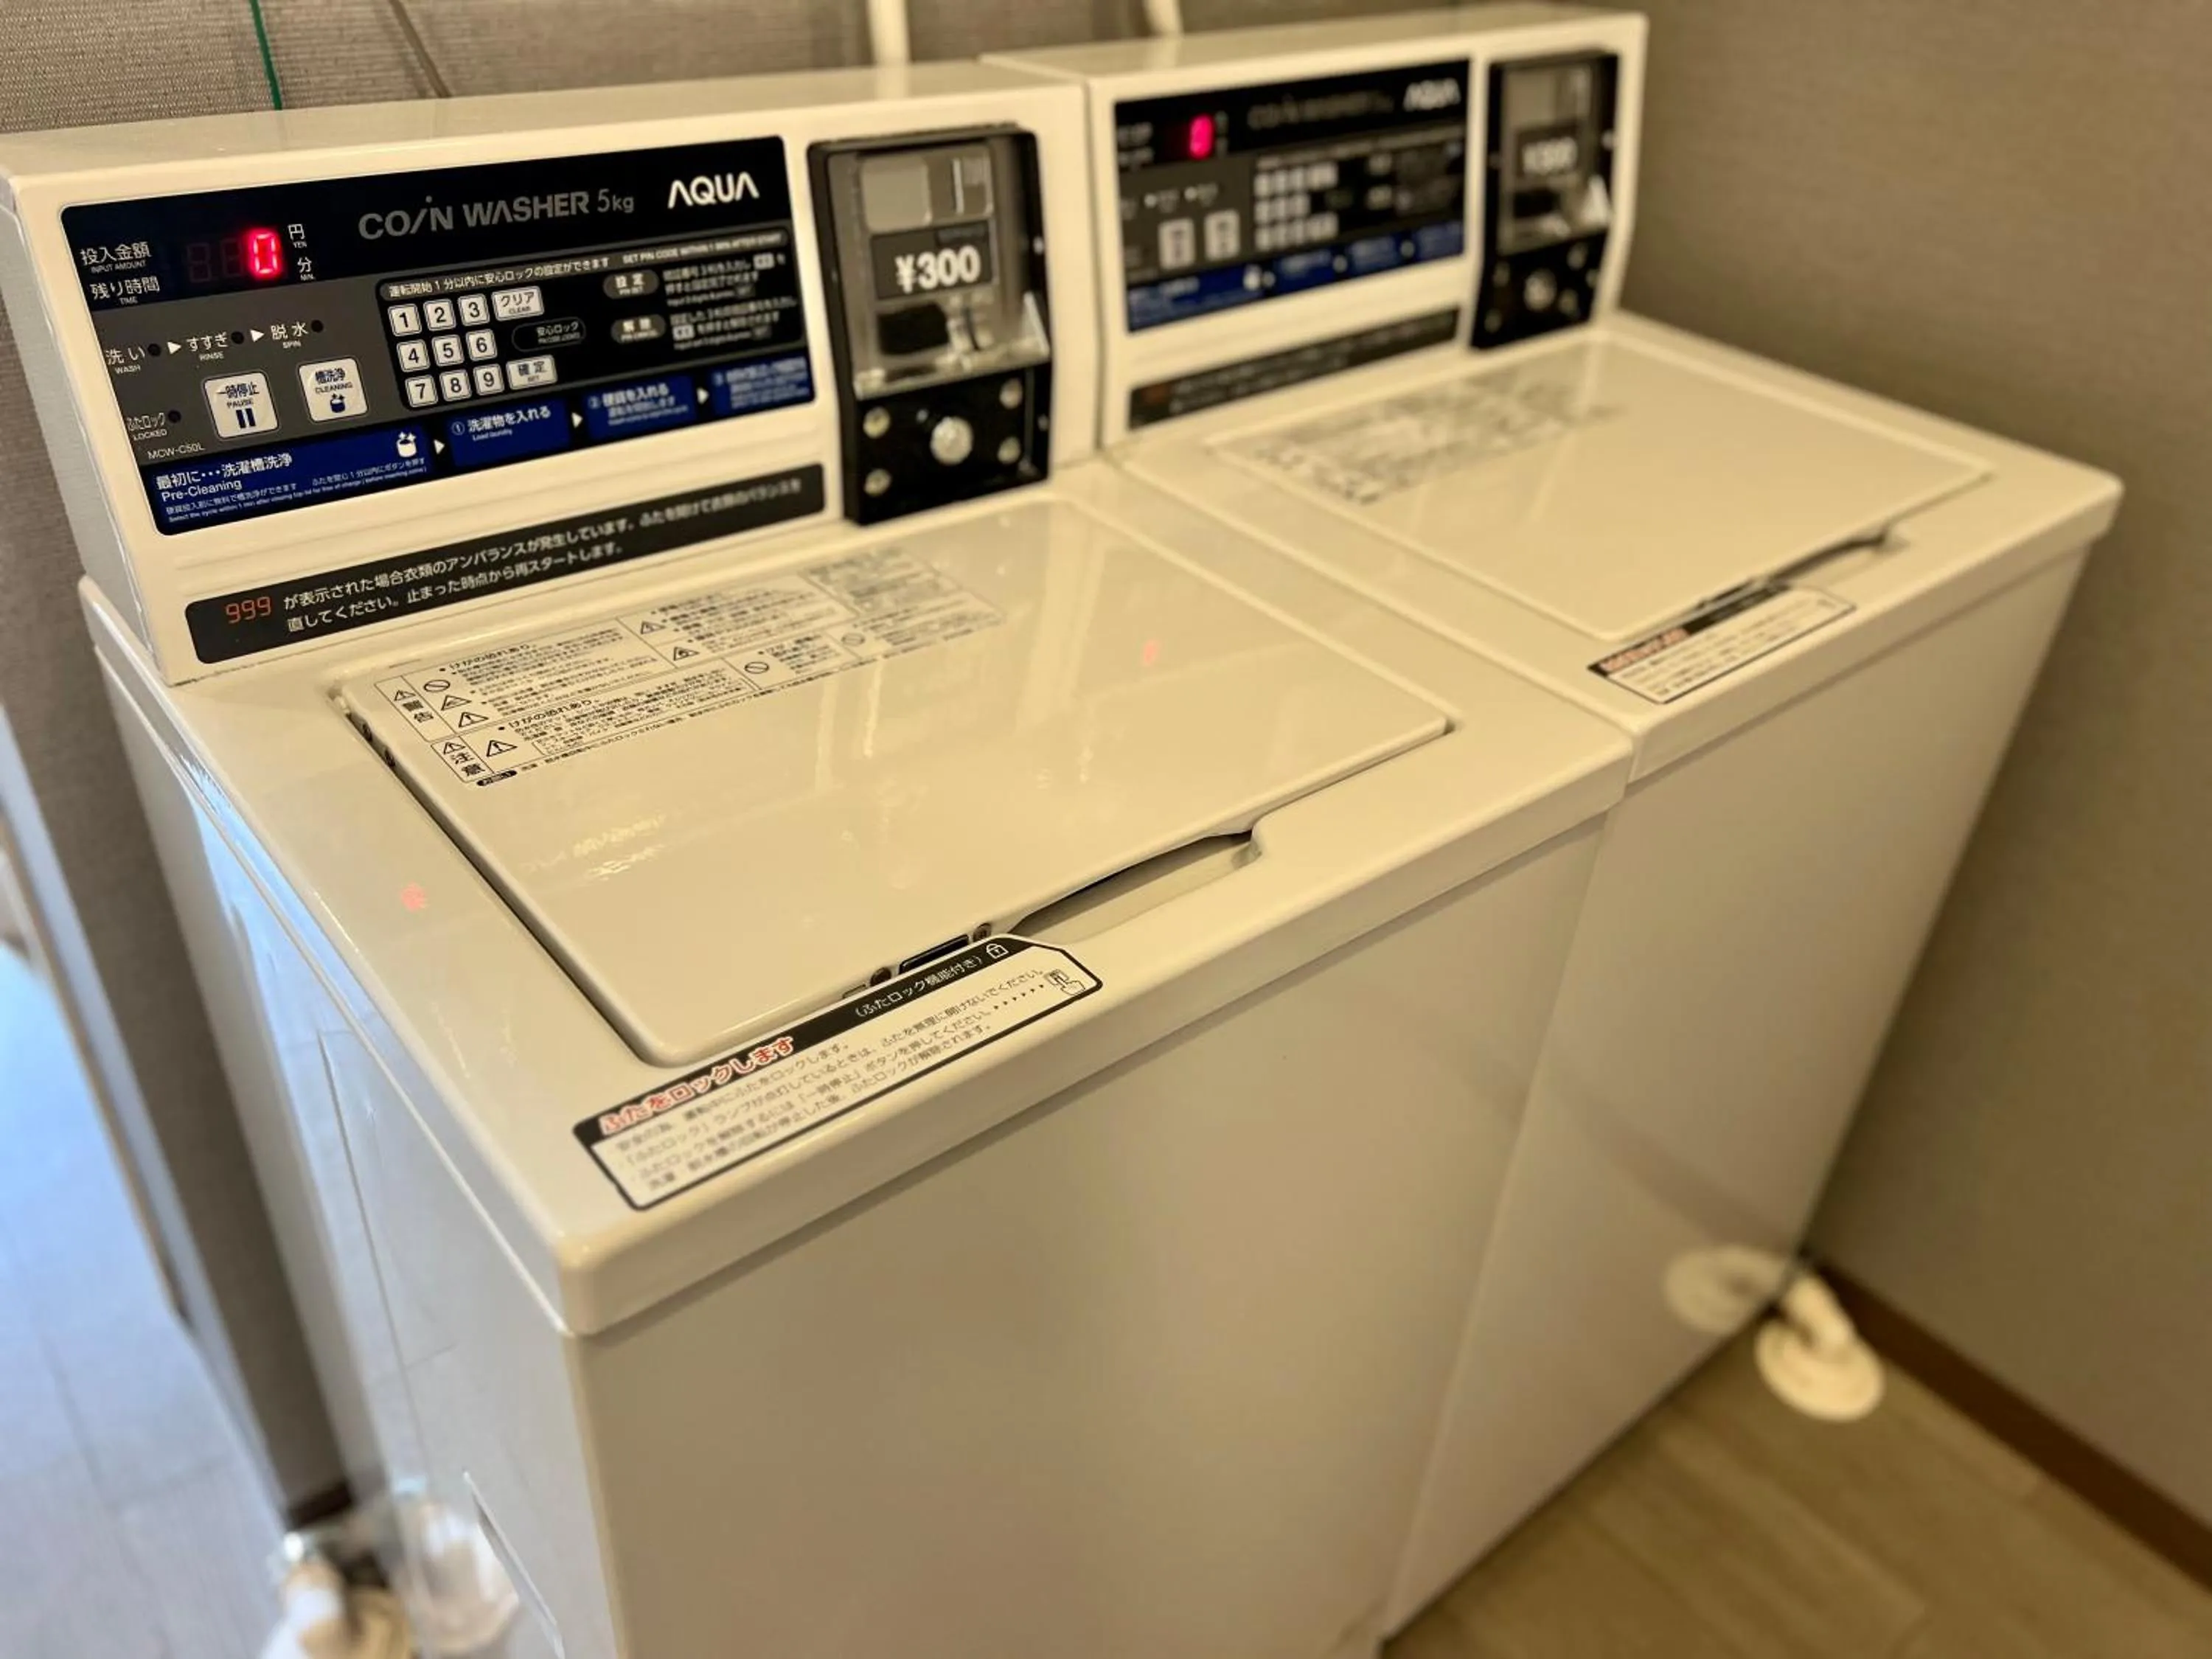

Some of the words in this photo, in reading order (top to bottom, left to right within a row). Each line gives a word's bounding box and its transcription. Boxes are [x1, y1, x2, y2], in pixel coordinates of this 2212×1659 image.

[667, 171, 759, 209] AQUA
[358, 195, 453, 240] COIN
[462, 191, 590, 228] WASHER
[597, 188, 635, 214] 5kg
[288, 223, 305, 240] 円
[80, 240, 152, 265] 投入金額
[249, 229, 282, 277] 0
[90, 262, 113, 274] INPUT
[114, 260, 146, 271] AMOUNT
[297, 257, 313, 274] 分
[894, 244, 981, 295] ¥300
[89, 275, 160, 300] 残り時間
[119, 296, 138, 305] TIME
[501, 291, 535, 307] クリア
[434, 306, 445, 324] 2
[468, 302, 480, 318] 3
[399, 313, 409, 328] 1
[271, 321, 308, 341] 脱水
[187, 333, 228, 352] すすぎ
[282, 340, 302, 349] SPIN
[443, 342, 454, 358] 5
[476, 337, 487, 353] 6
[105, 347, 145, 366] 洗い
[200, 351, 224, 361] RINSE
[408, 347, 420, 364] 4
[115, 364, 141, 375] WASH
[315, 382, 353, 394] CLEANING
[451, 377, 462, 394] 8
[483, 372, 494, 387] 9
[217, 381, 260, 399] 一時停止
[415, 383, 426, 400] 7
[226, 398, 254, 408] PAUSE
[133, 428, 167, 441] LOCKED
[161, 480, 243, 502] Pre-Cleaning
[225, 595, 272, 625] 999
[599, 1036, 794, 1135] ふたをロックします
